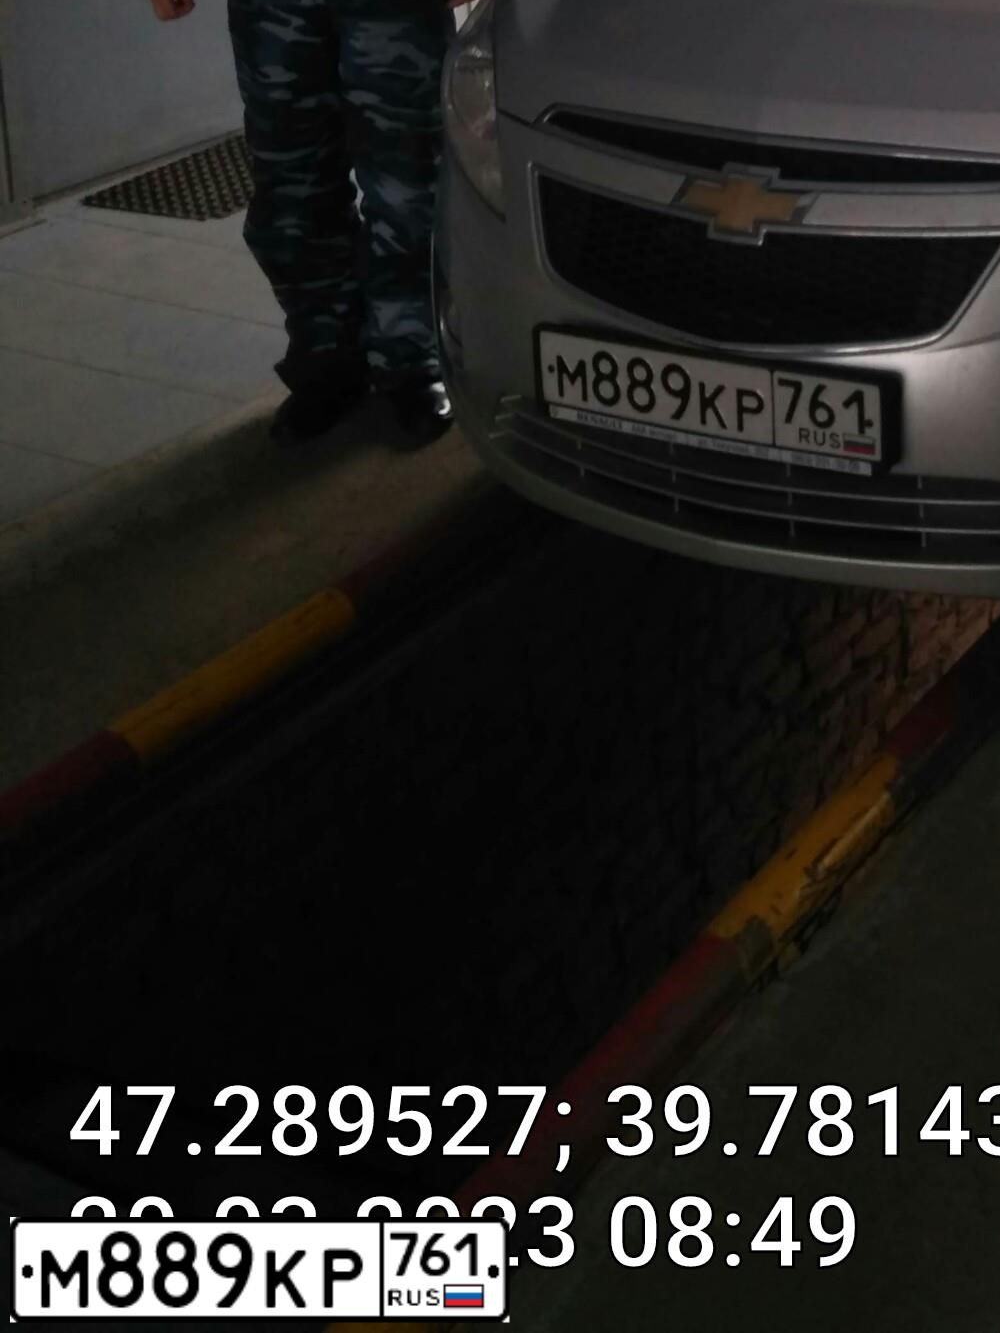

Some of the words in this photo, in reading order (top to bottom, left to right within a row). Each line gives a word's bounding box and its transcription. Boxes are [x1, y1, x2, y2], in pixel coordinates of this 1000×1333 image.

[556, 350, 765, 433] М889КР
[777, 378, 869, 435] 761
[799, 427, 842, 451] RUS
